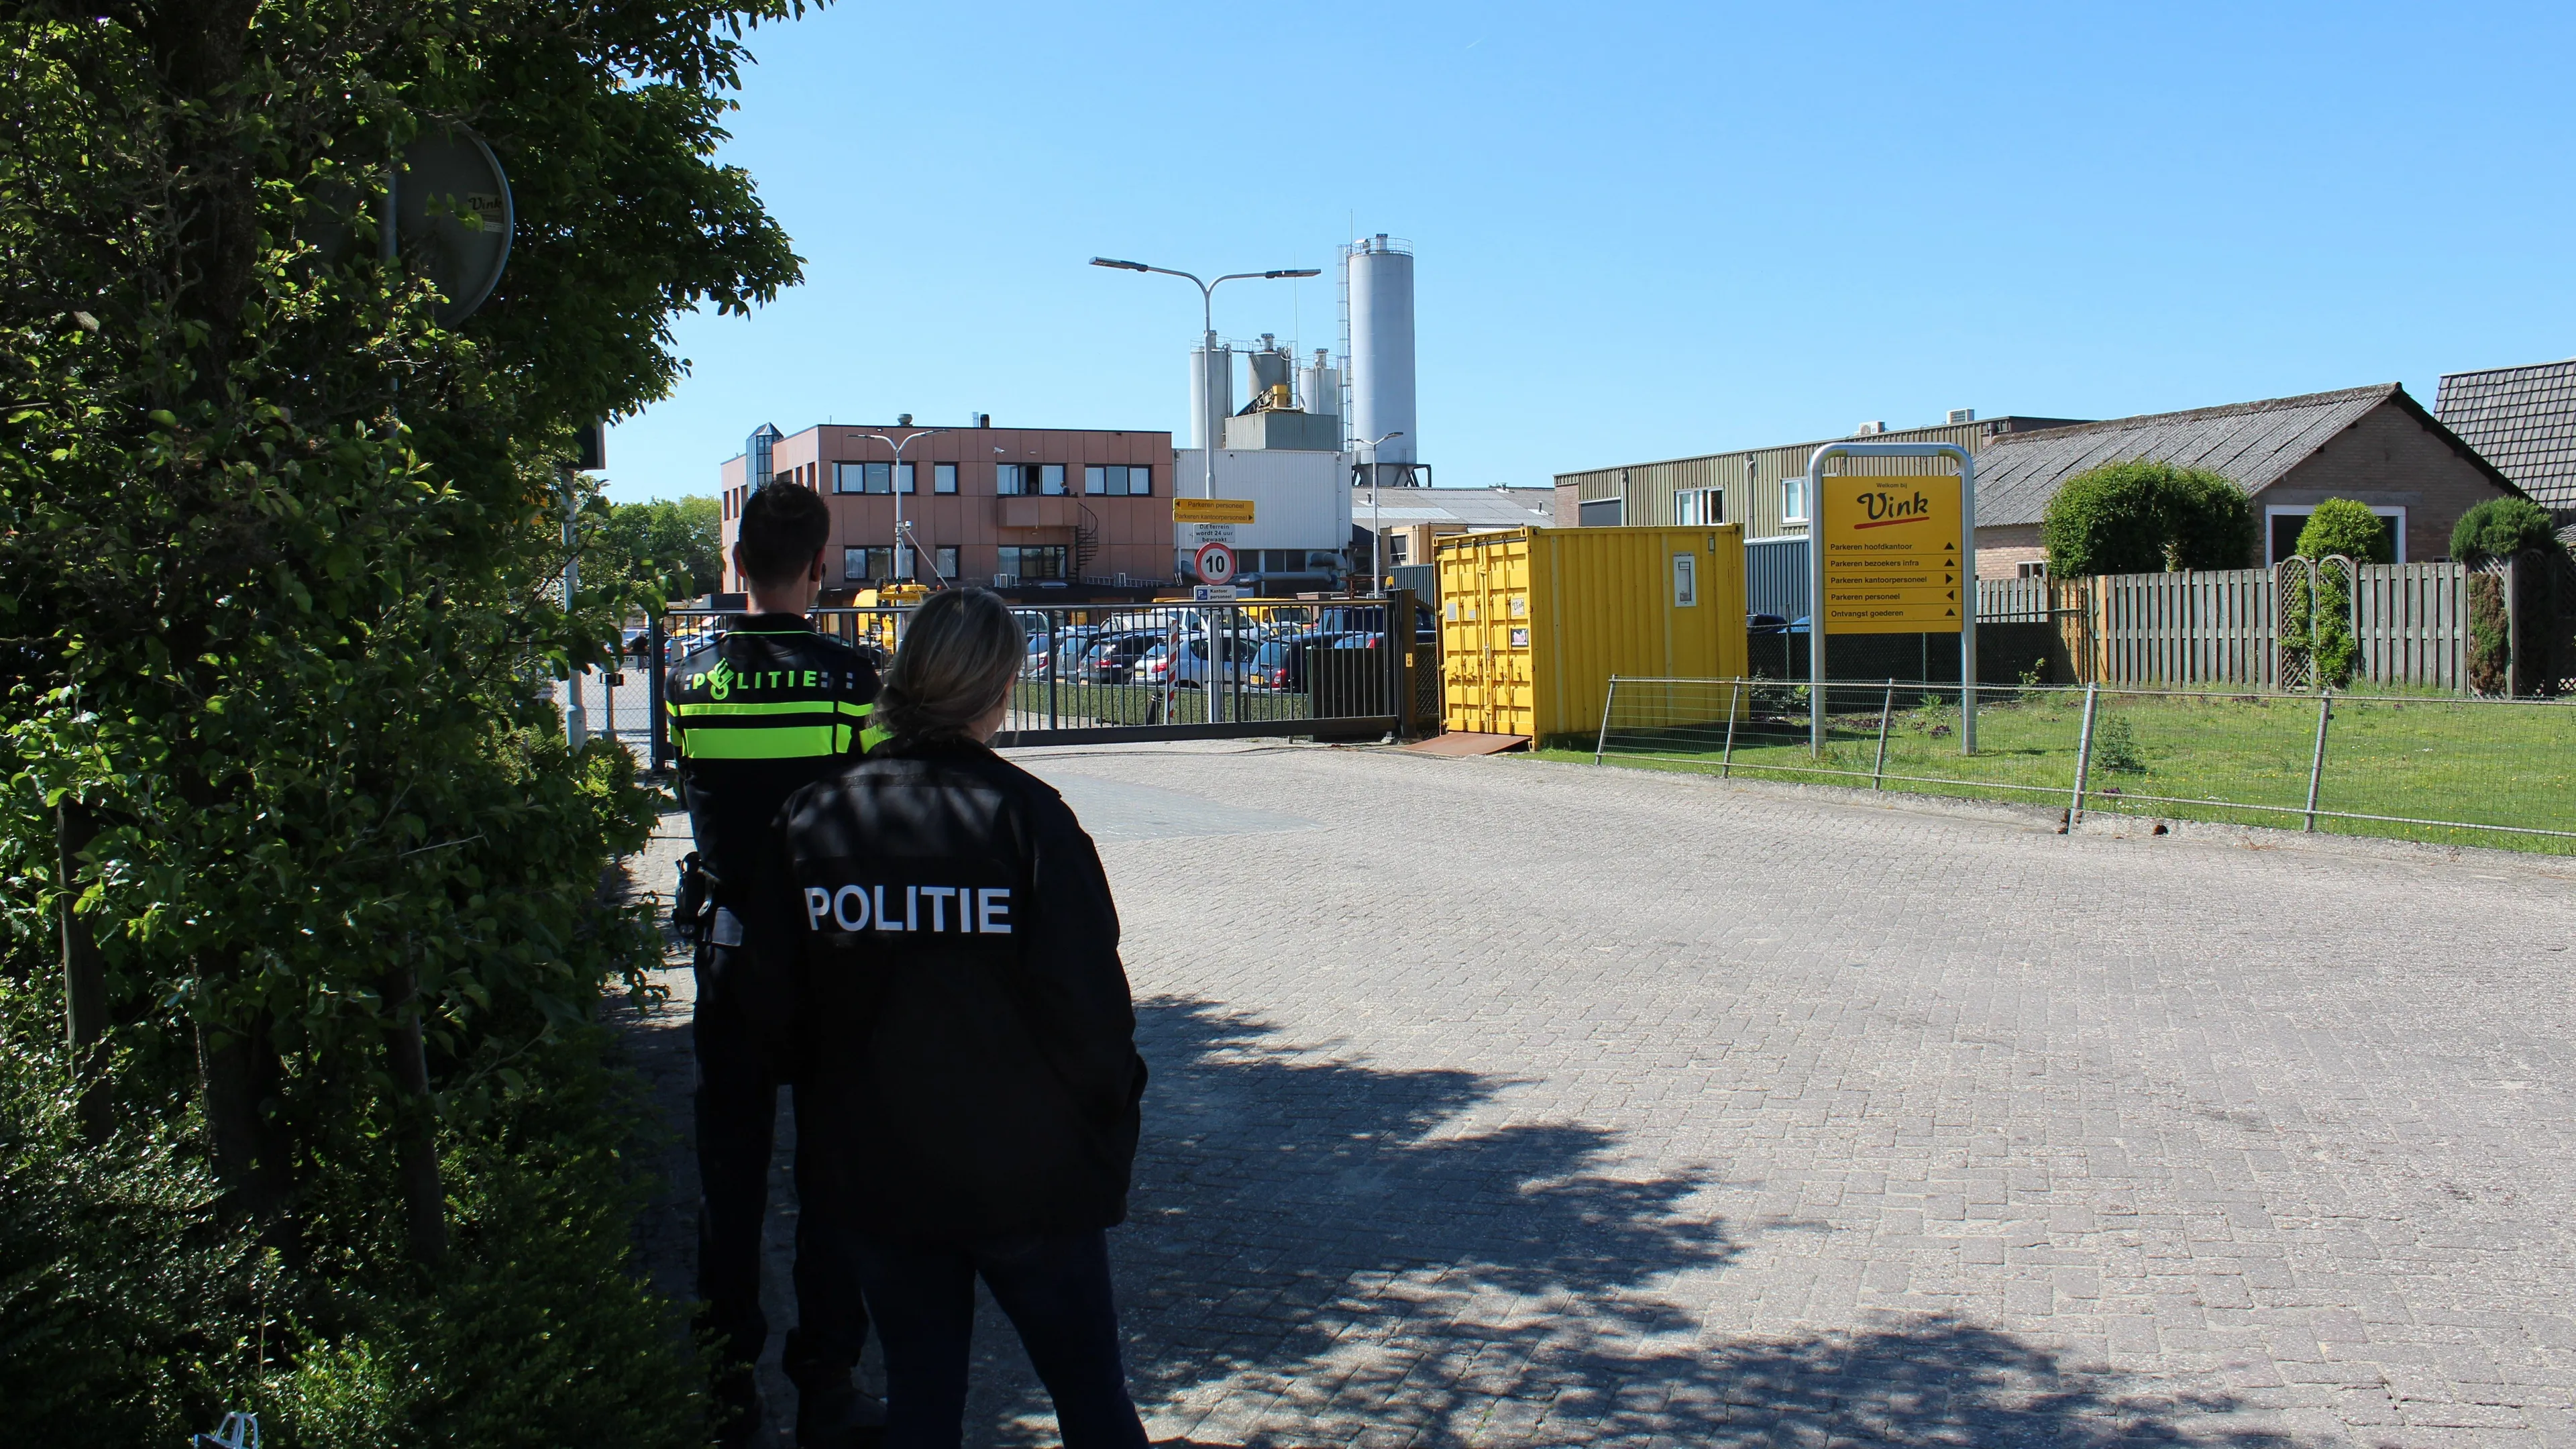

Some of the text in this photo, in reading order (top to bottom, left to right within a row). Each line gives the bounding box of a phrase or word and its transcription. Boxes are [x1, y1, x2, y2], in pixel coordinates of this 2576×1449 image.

[468, 197, 502, 211] Vink
[1856, 491, 1929, 520] Vink
[1205, 555, 1225, 573] 10
[1864, 576, 1927, 584] kantoorpersoneel
[1864, 593, 1900, 602] personeel
[1831, 610, 1904, 619] Ontvangst goederen
[692, 670, 817, 700] POLITIE
[804, 884, 1012, 934] POLITIE
